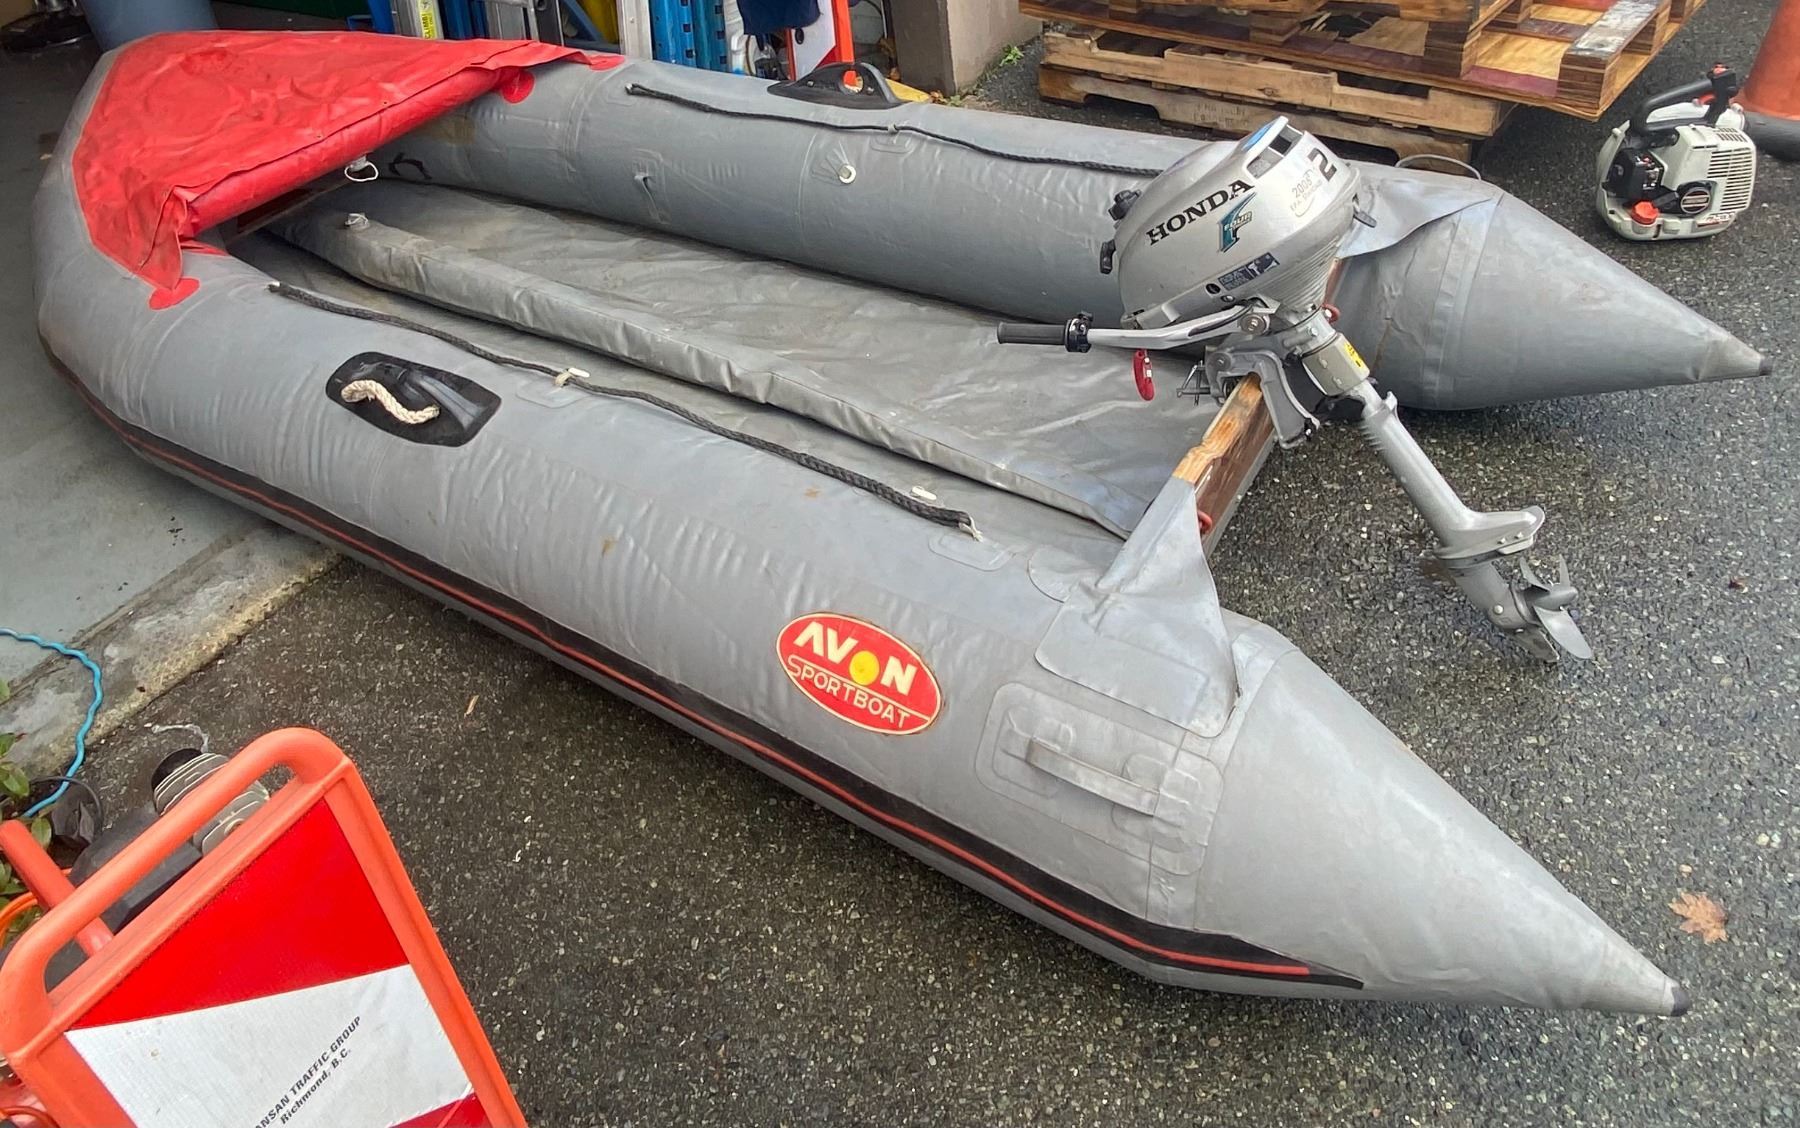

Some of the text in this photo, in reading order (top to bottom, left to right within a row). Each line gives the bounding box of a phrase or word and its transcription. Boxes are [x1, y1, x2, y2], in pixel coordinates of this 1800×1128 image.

[1306, 147, 1338, 182] 2
[1145, 179, 1254, 246] HONDA
[786, 653, 911, 729] SPORTBOAT
[793, 620, 918, 696] AVON
[279, 1047, 352, 1125] Richmond, B.C.
[289, 1051, 330, 1096] TRAFFIC
[329, 1015, 362, 1053] GROUP
